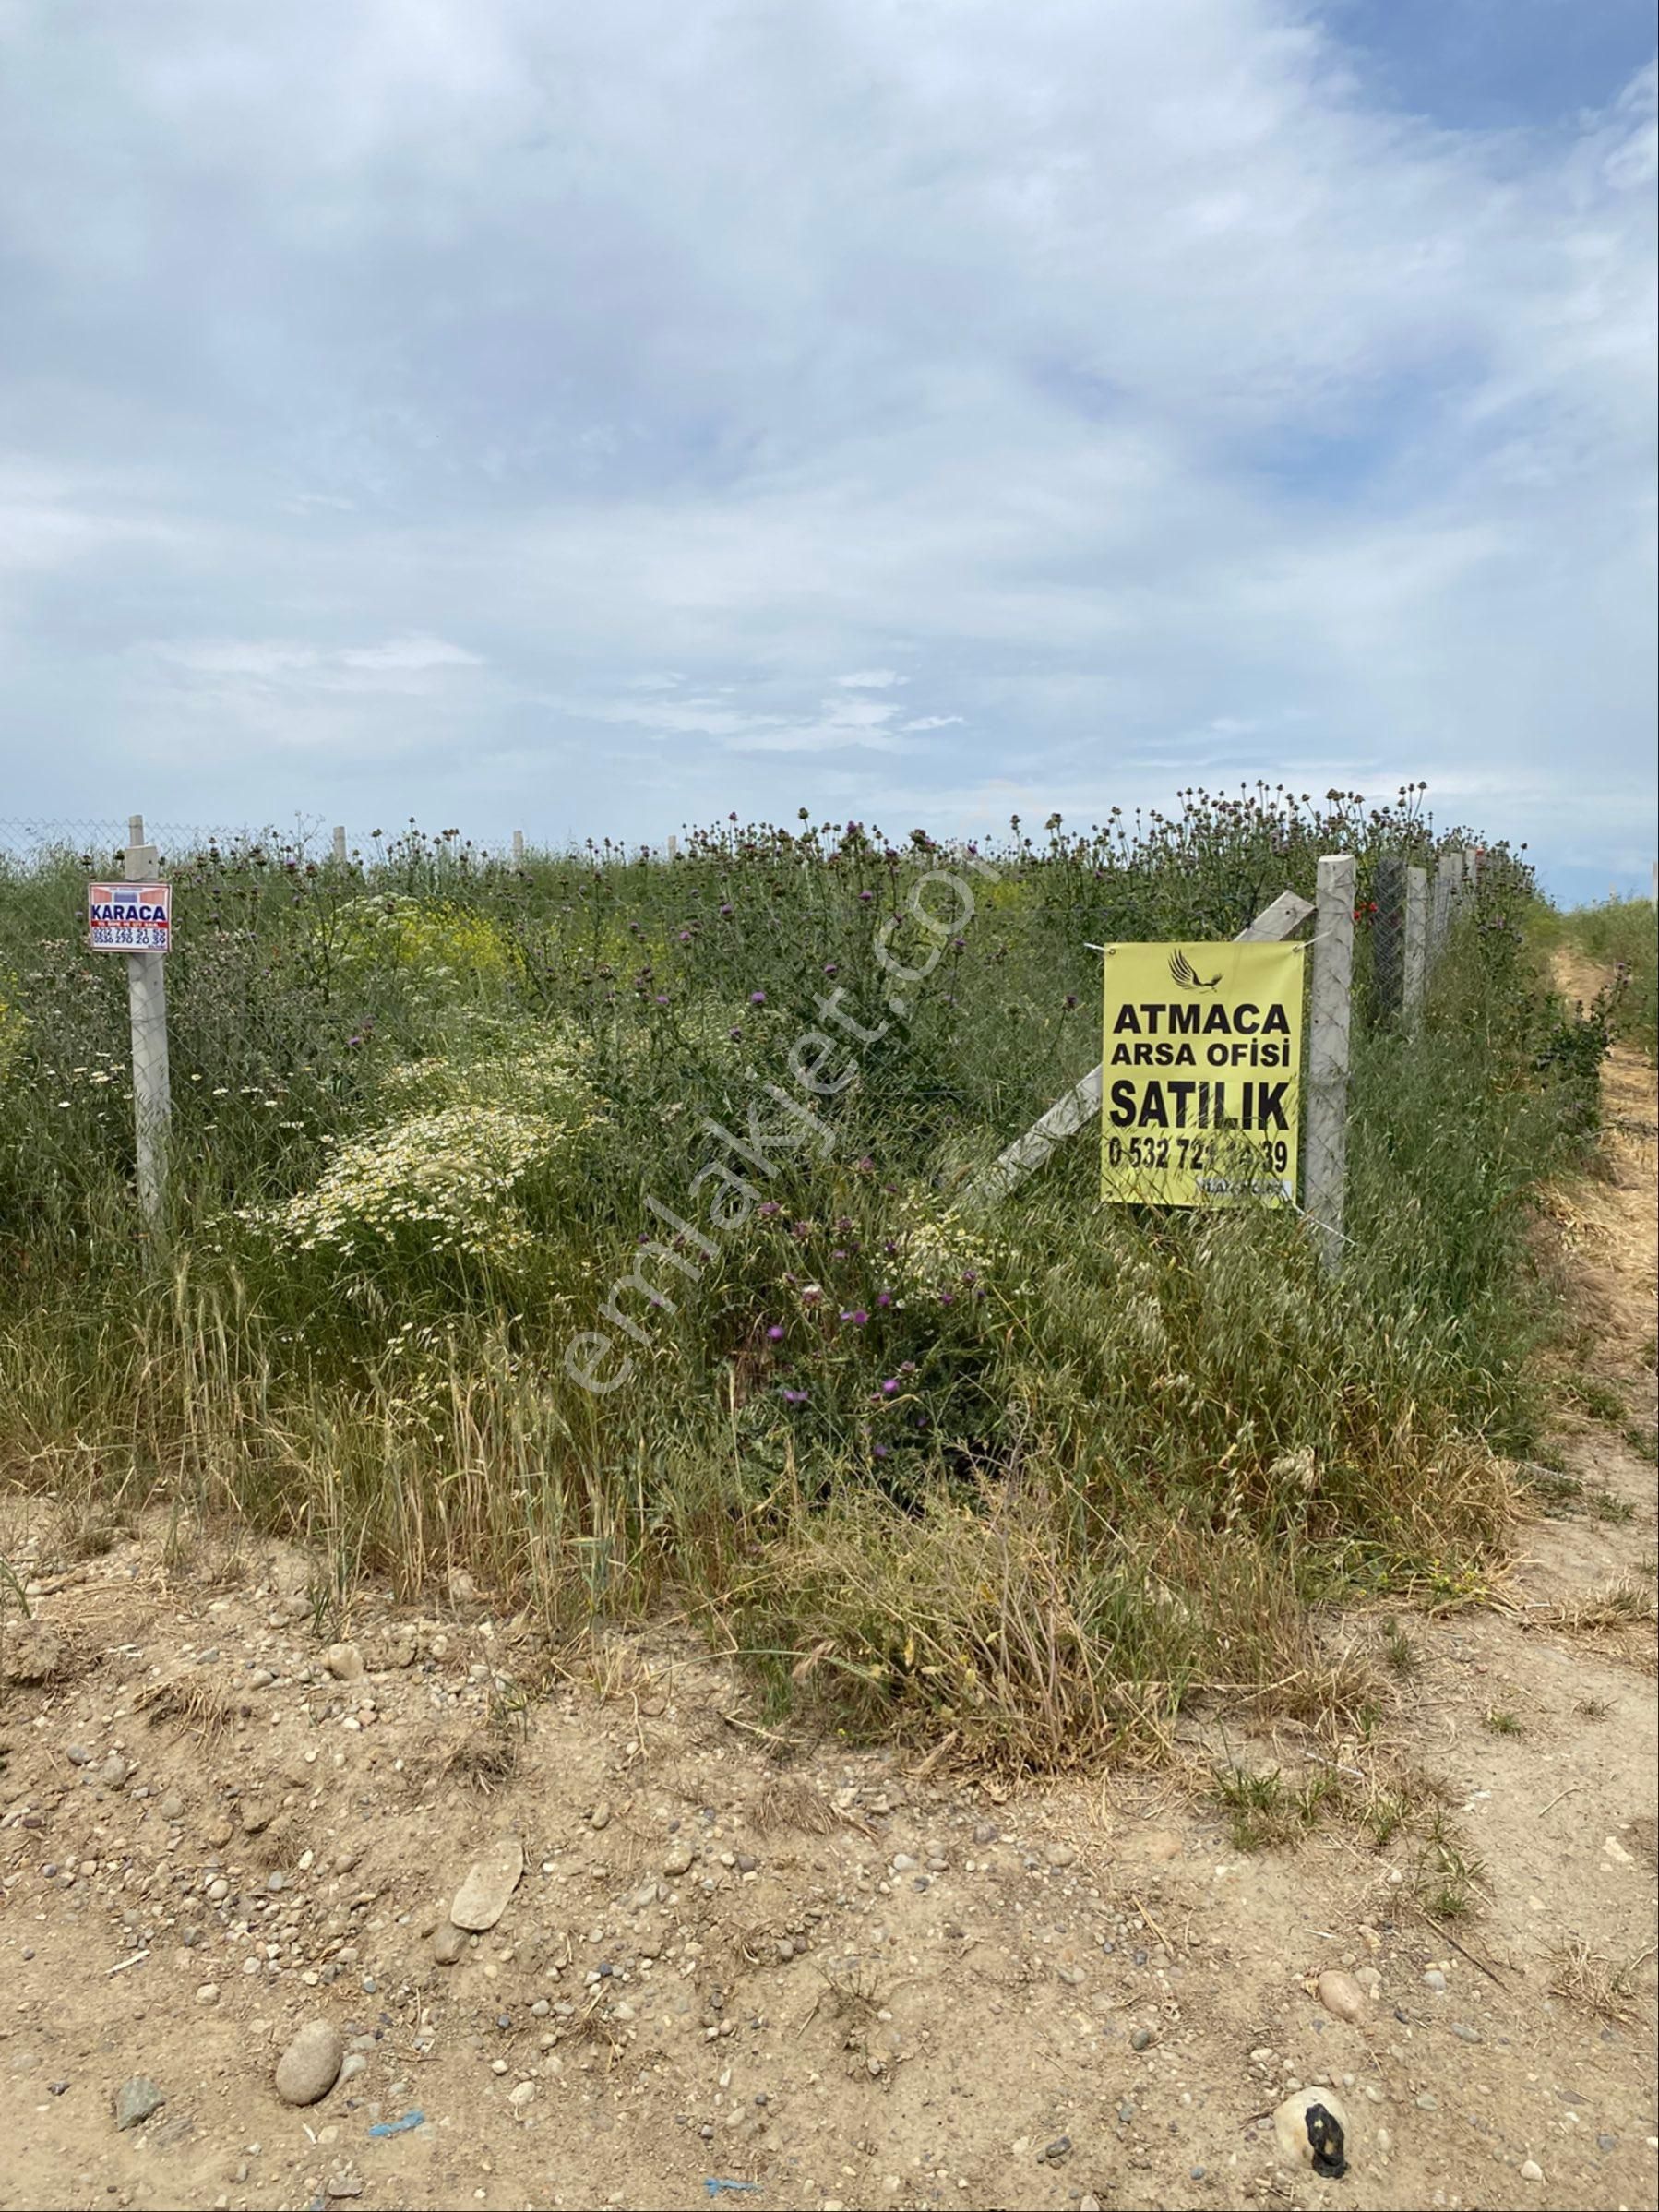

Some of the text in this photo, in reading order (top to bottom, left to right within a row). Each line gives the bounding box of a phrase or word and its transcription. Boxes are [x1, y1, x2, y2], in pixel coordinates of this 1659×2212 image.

[91, 904, 166, 921] KARACA
[115, 936, 133, 944] 270
[136, 936, 150, 944] 20
[1113, 1003, 1291, 1034] ATMACA
[1111, 1038, 1290, 1067] ARSA OFİSİ
[1109, 1080, 1290, 1130] SATILIK
[1108, 1137, 1121, 1168] 0
[1129, 1138, 1169, 1169] 532
[1263, 1141, 1287, 1173] 39
